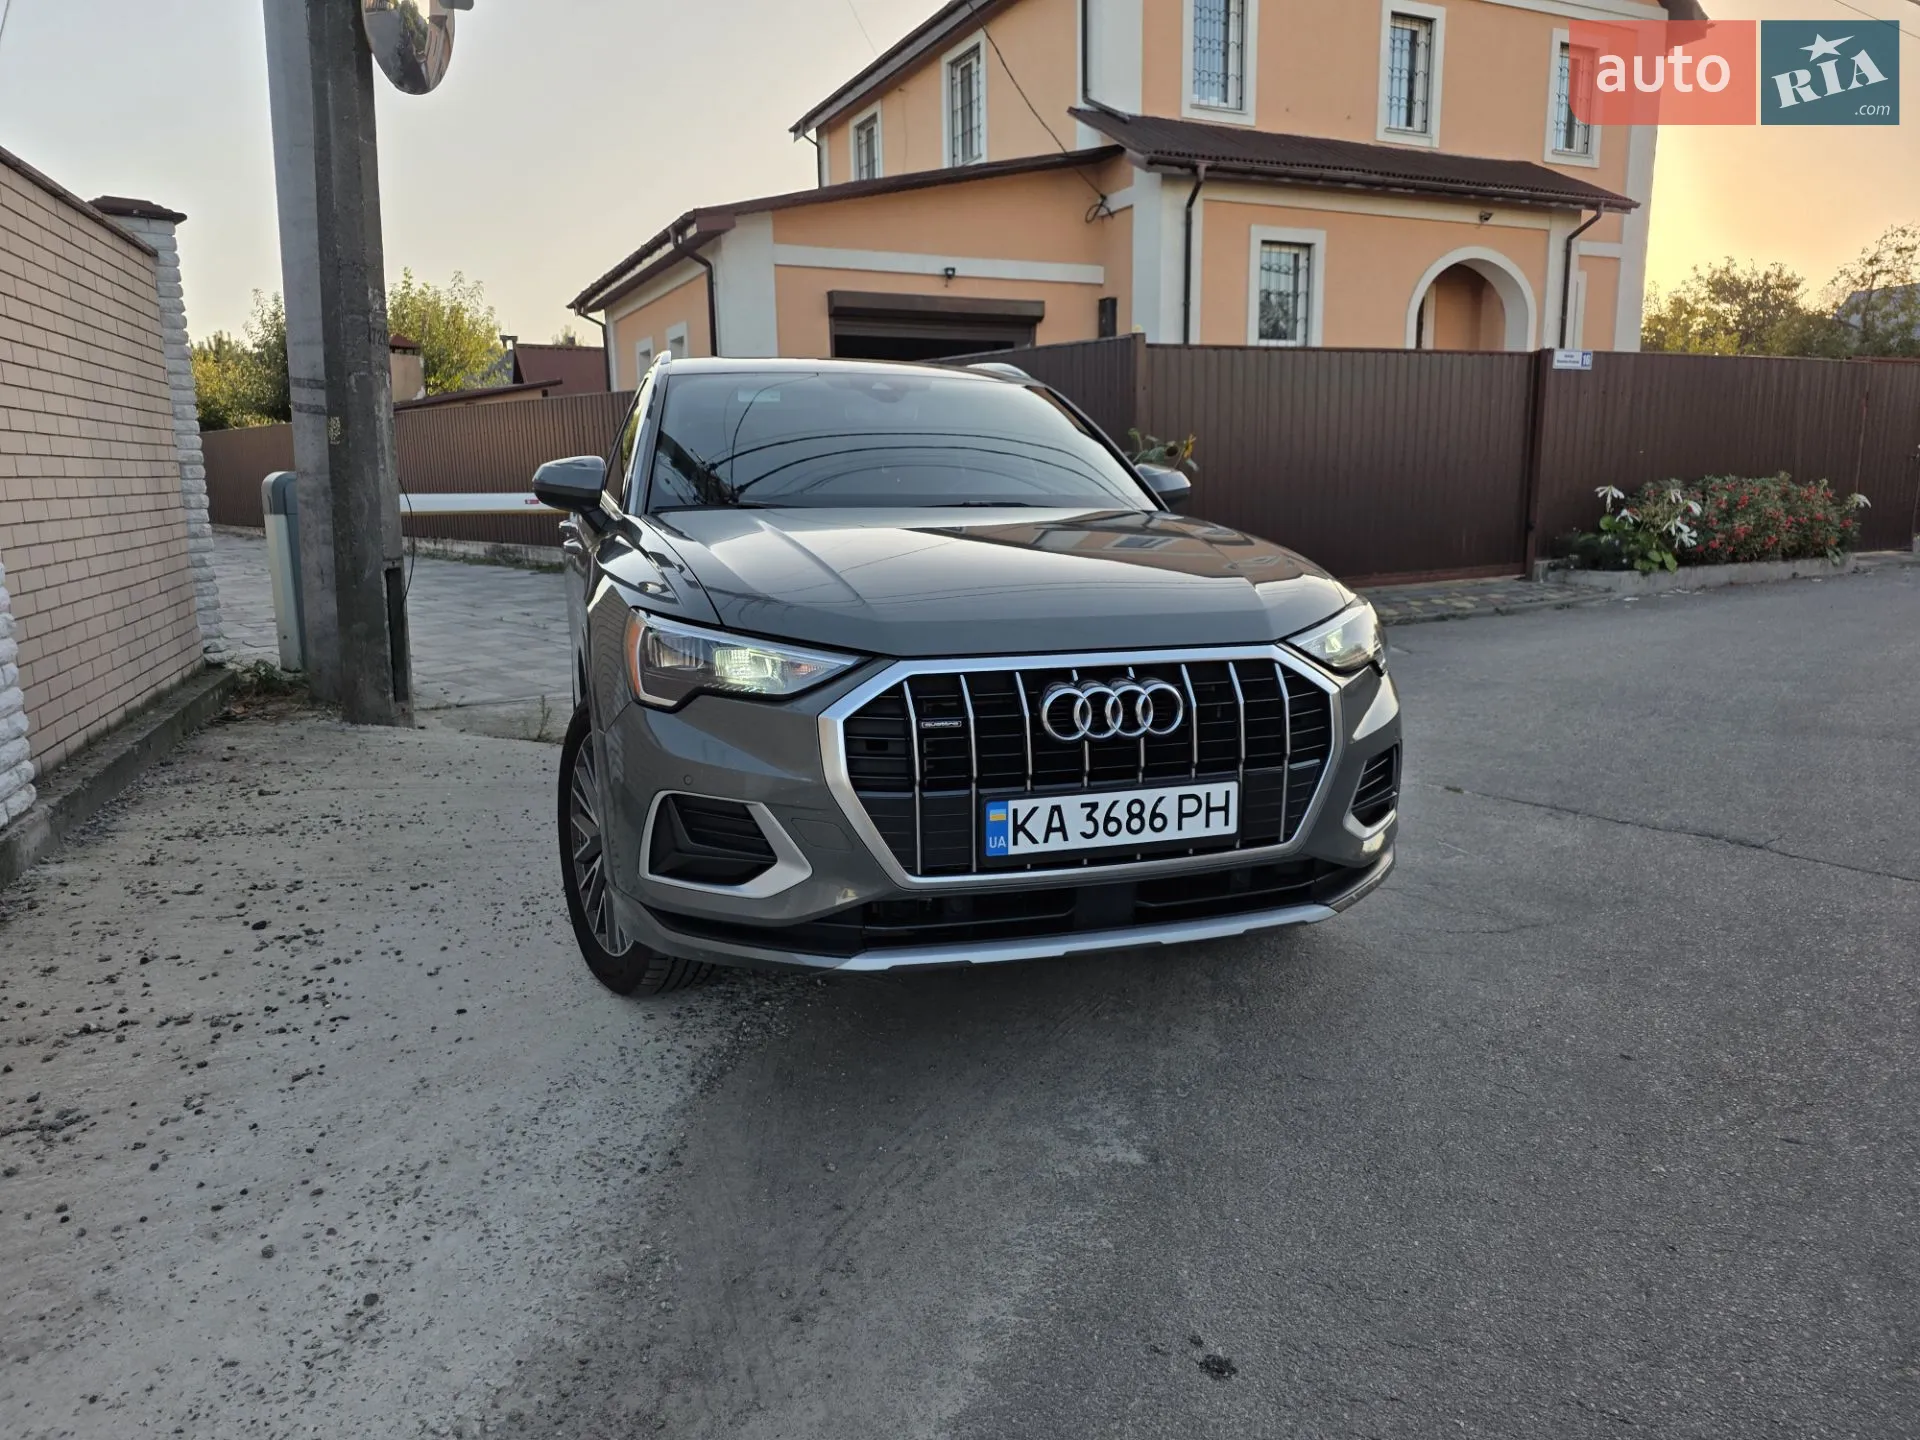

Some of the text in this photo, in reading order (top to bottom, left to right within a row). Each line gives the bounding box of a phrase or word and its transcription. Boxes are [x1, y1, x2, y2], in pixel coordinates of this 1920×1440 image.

[1012, 790, 1230, 846] KA 3686 PH
[989, 836, 1007, 849] UA
